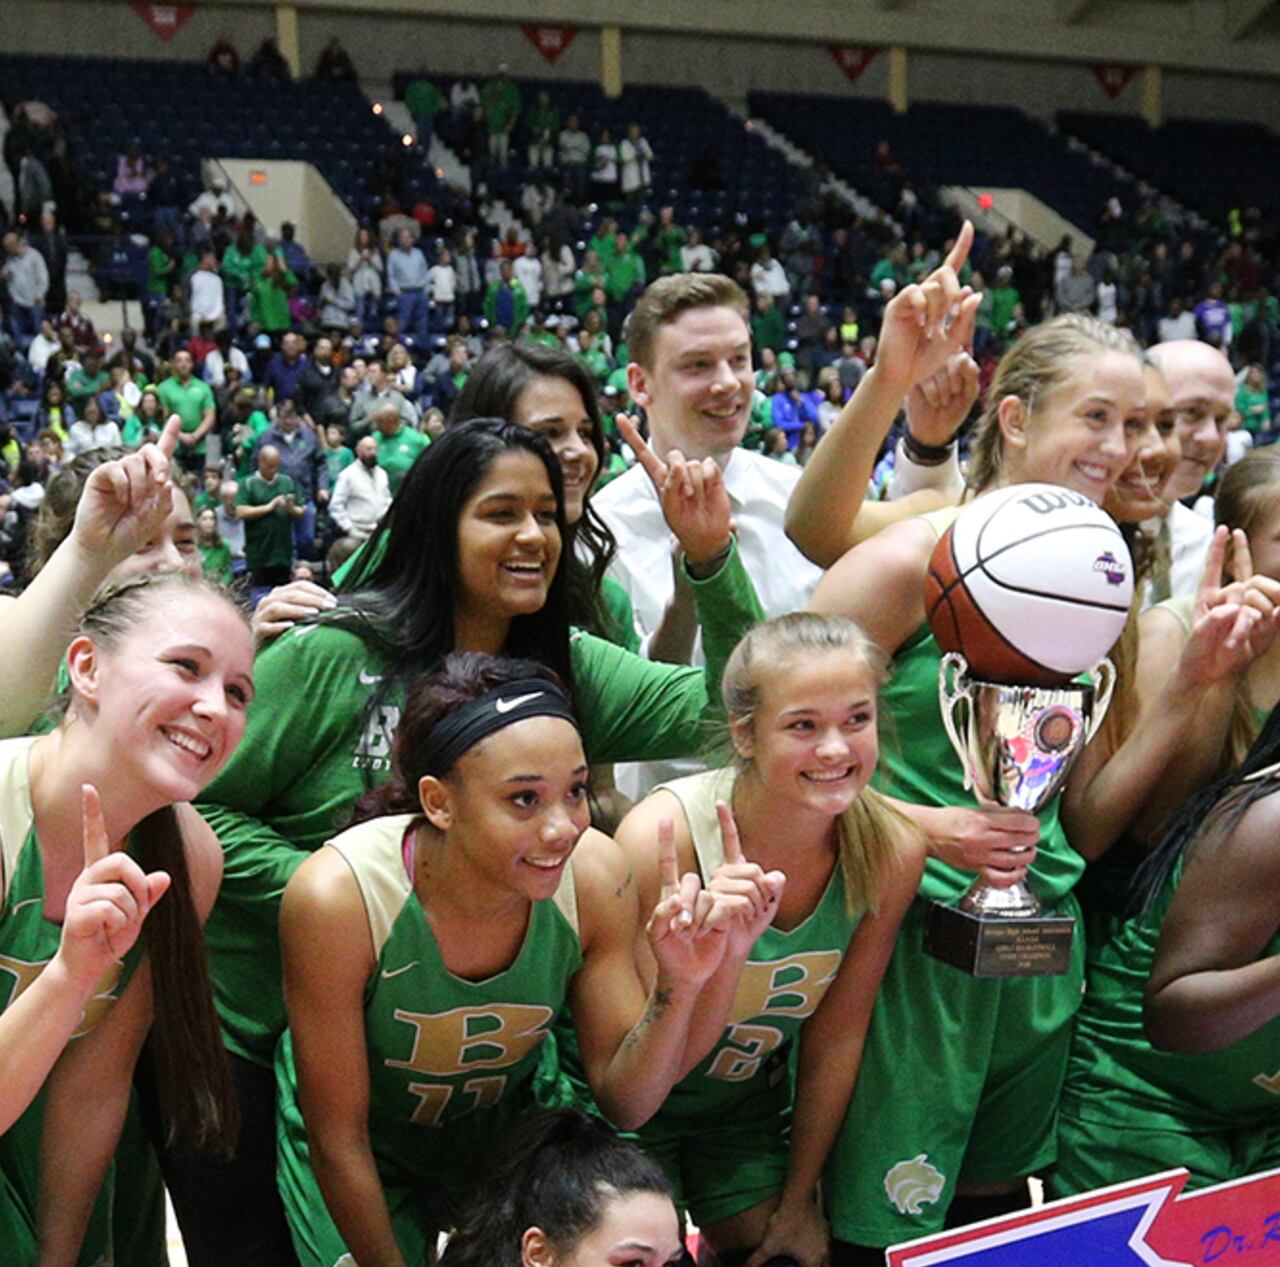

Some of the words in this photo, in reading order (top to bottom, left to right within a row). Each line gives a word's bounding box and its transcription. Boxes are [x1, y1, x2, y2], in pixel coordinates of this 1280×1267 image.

[728, 949, 843, 1026] B
[384, 1003, 554, 1076] B
[1200, 1225, 1254, 1264] Dr.
